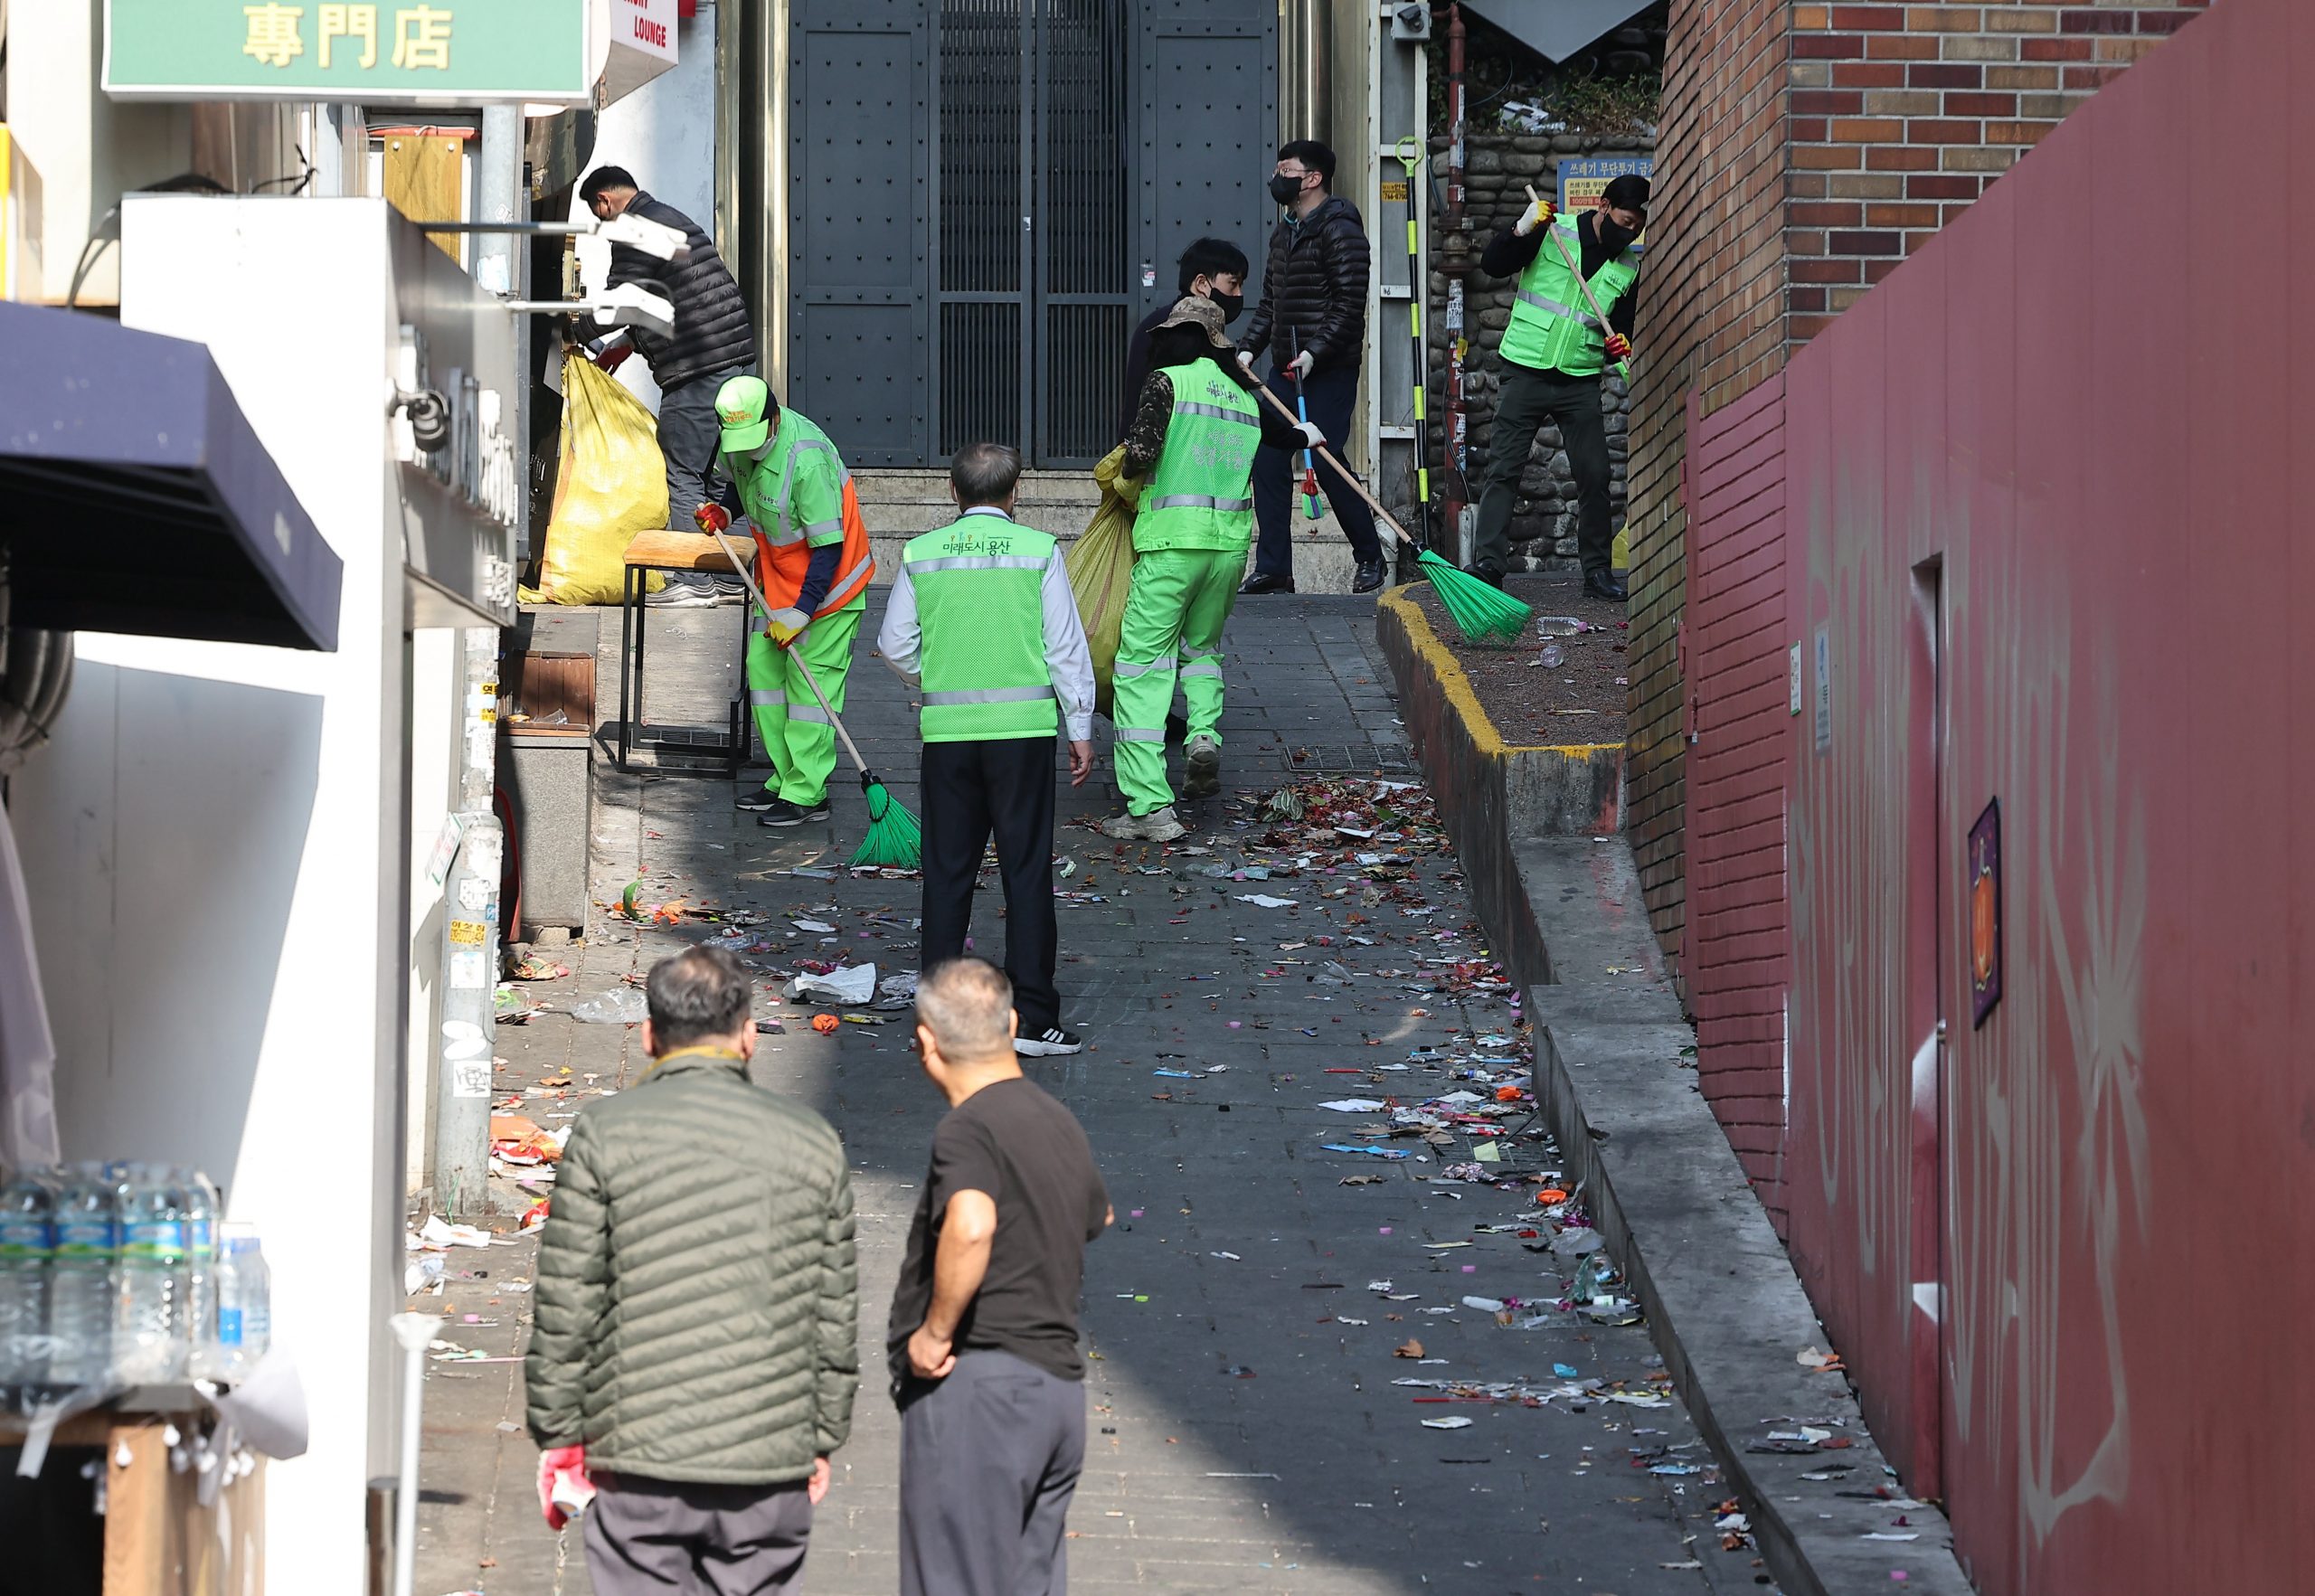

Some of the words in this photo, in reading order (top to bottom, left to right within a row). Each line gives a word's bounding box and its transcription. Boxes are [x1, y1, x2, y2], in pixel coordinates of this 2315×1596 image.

[242, 3, 453, 70] 專門店
[635, 15, 666, 48] LOUNGE
[1569, 163, 1596, 176] 쓰레기
[1600, 162, 1635, 176] 무단투기
[942, 541, 985, 555] 미래도시
[987, 541, 1011, 556] 용산
